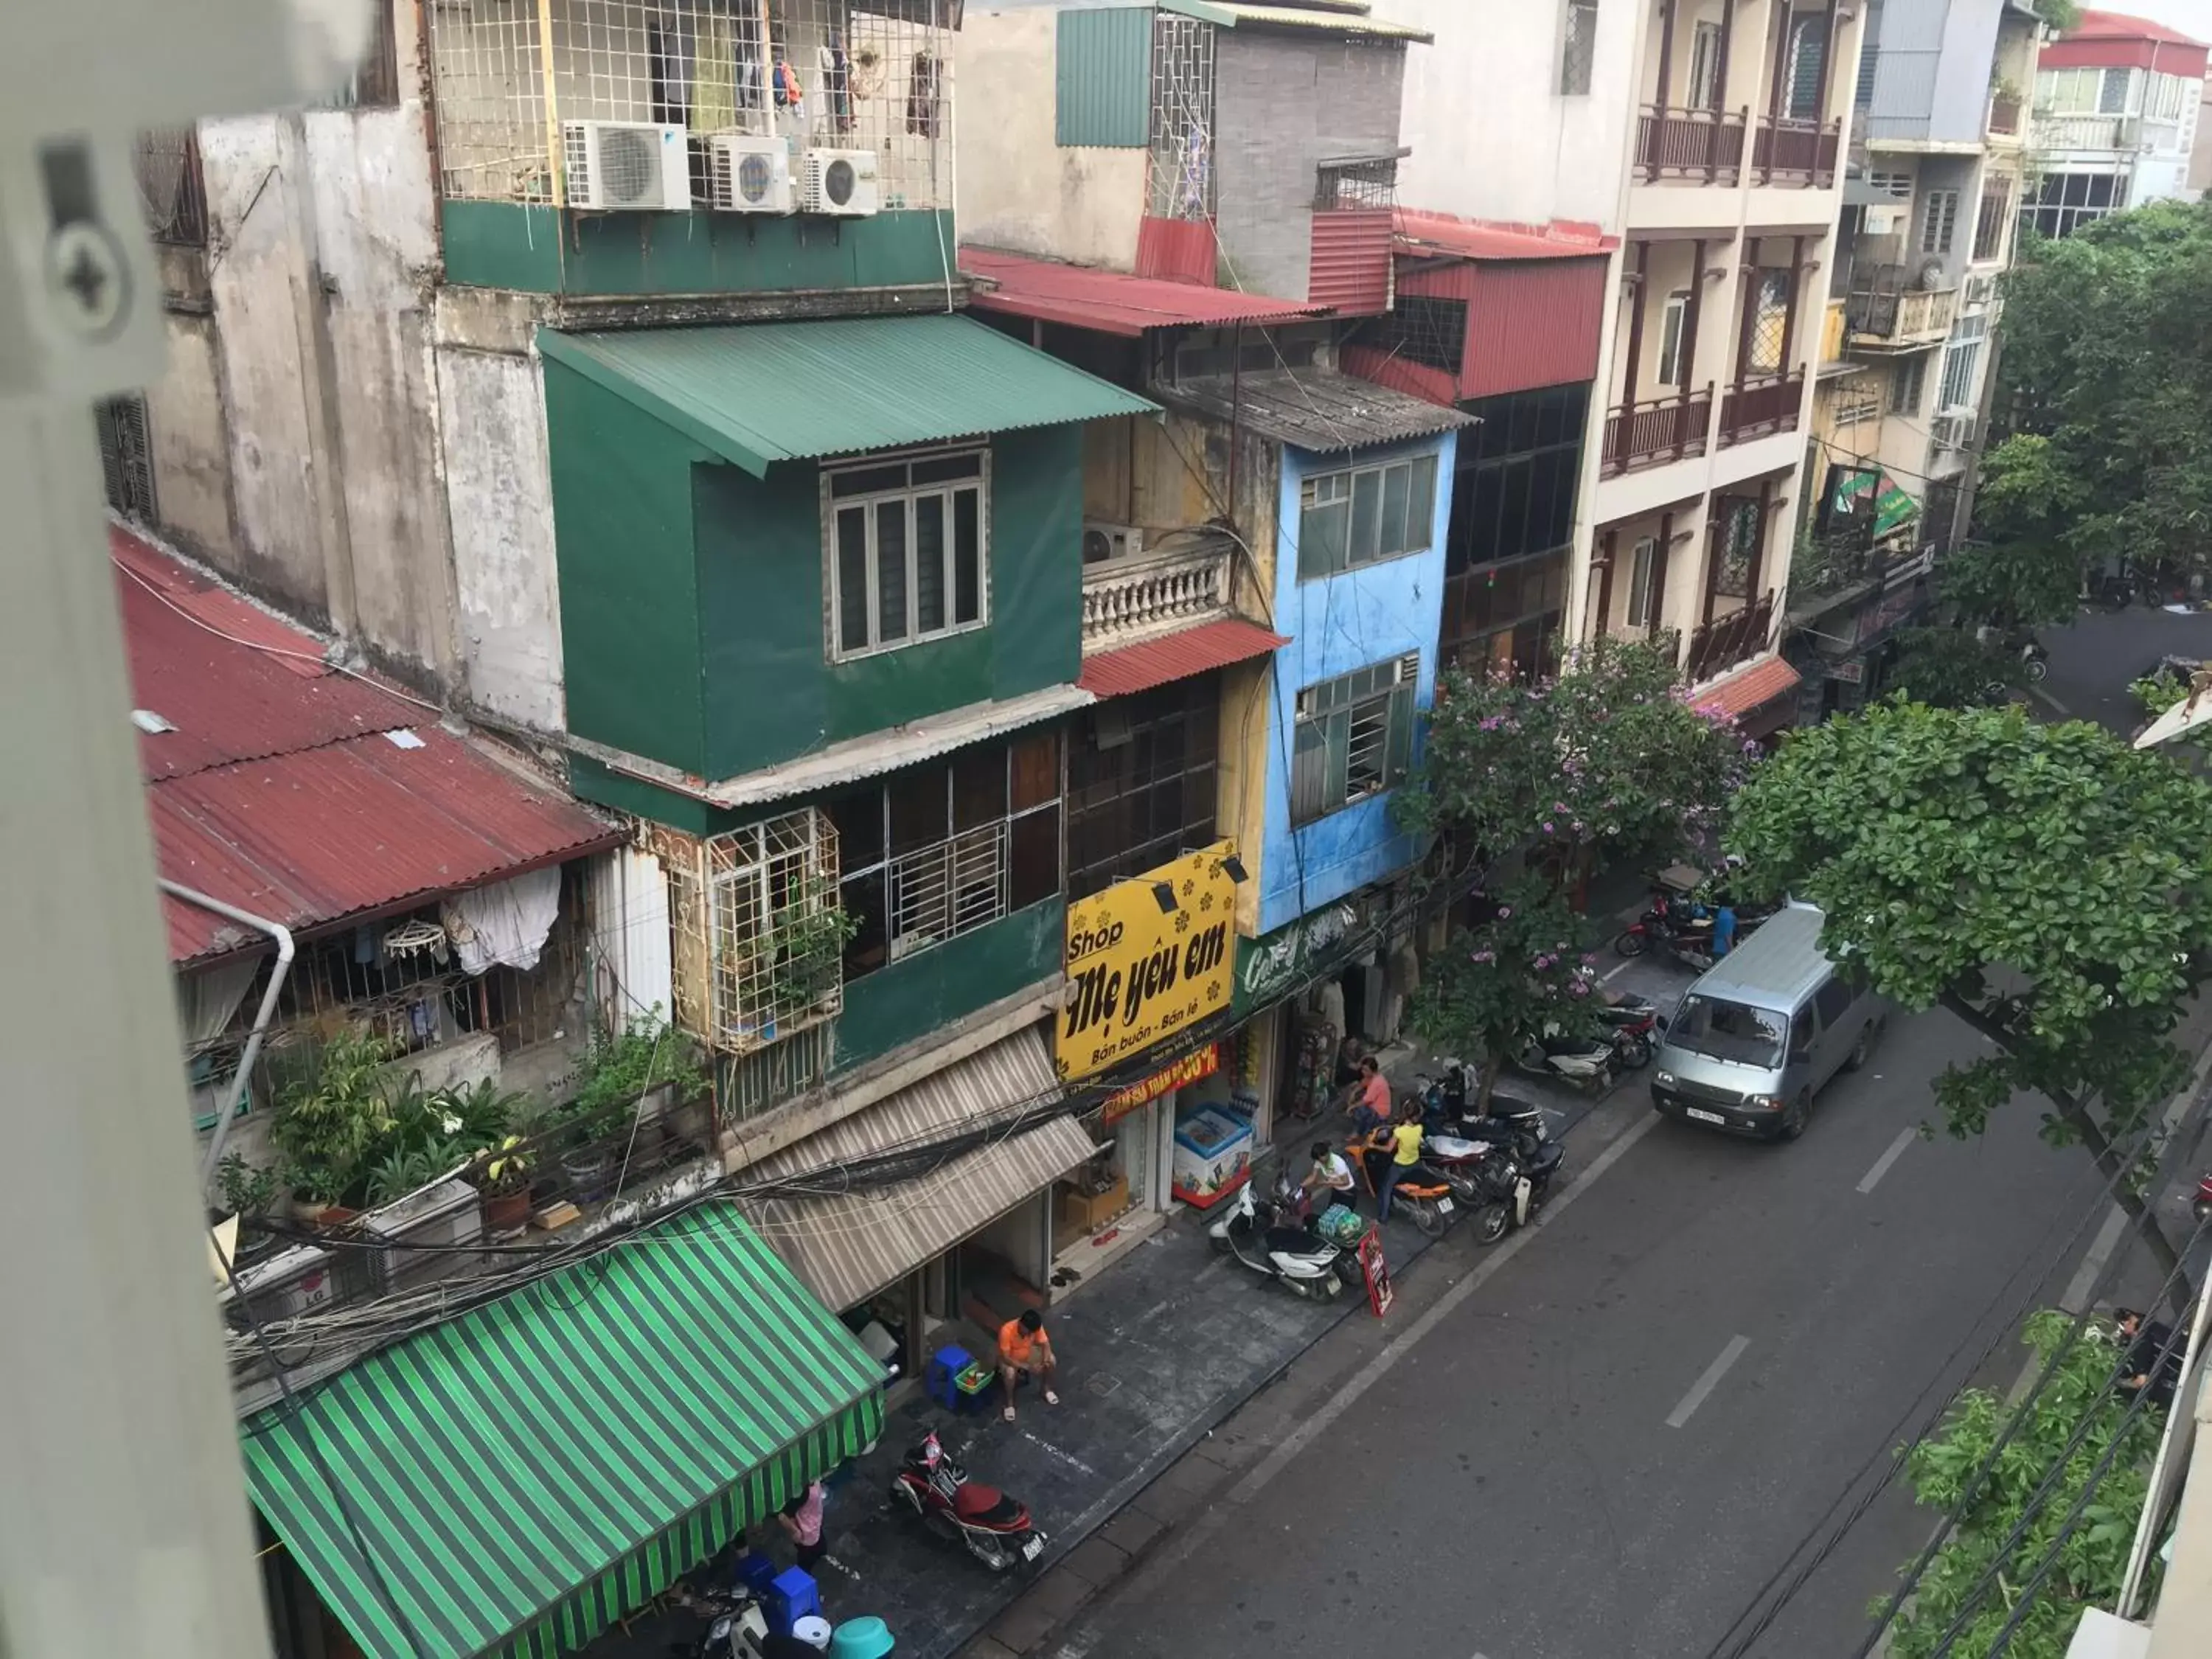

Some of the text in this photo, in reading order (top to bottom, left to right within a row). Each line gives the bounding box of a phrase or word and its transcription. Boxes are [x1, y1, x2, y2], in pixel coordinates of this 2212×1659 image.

[1069, 921, 1124, 960] Shop
[1065, 961, 1122, 1038] Mẹ
[1121, 935, 1180, 1027] yêu
[1183, 920, 1227, 980] em
[1091, 1040, 1117, 1065] Bán
[1119, 1025, 1152, 1051] buôn
[1161, 1009, 1184, 1030] Bán
[306, 1290, 324, 1308] LG
